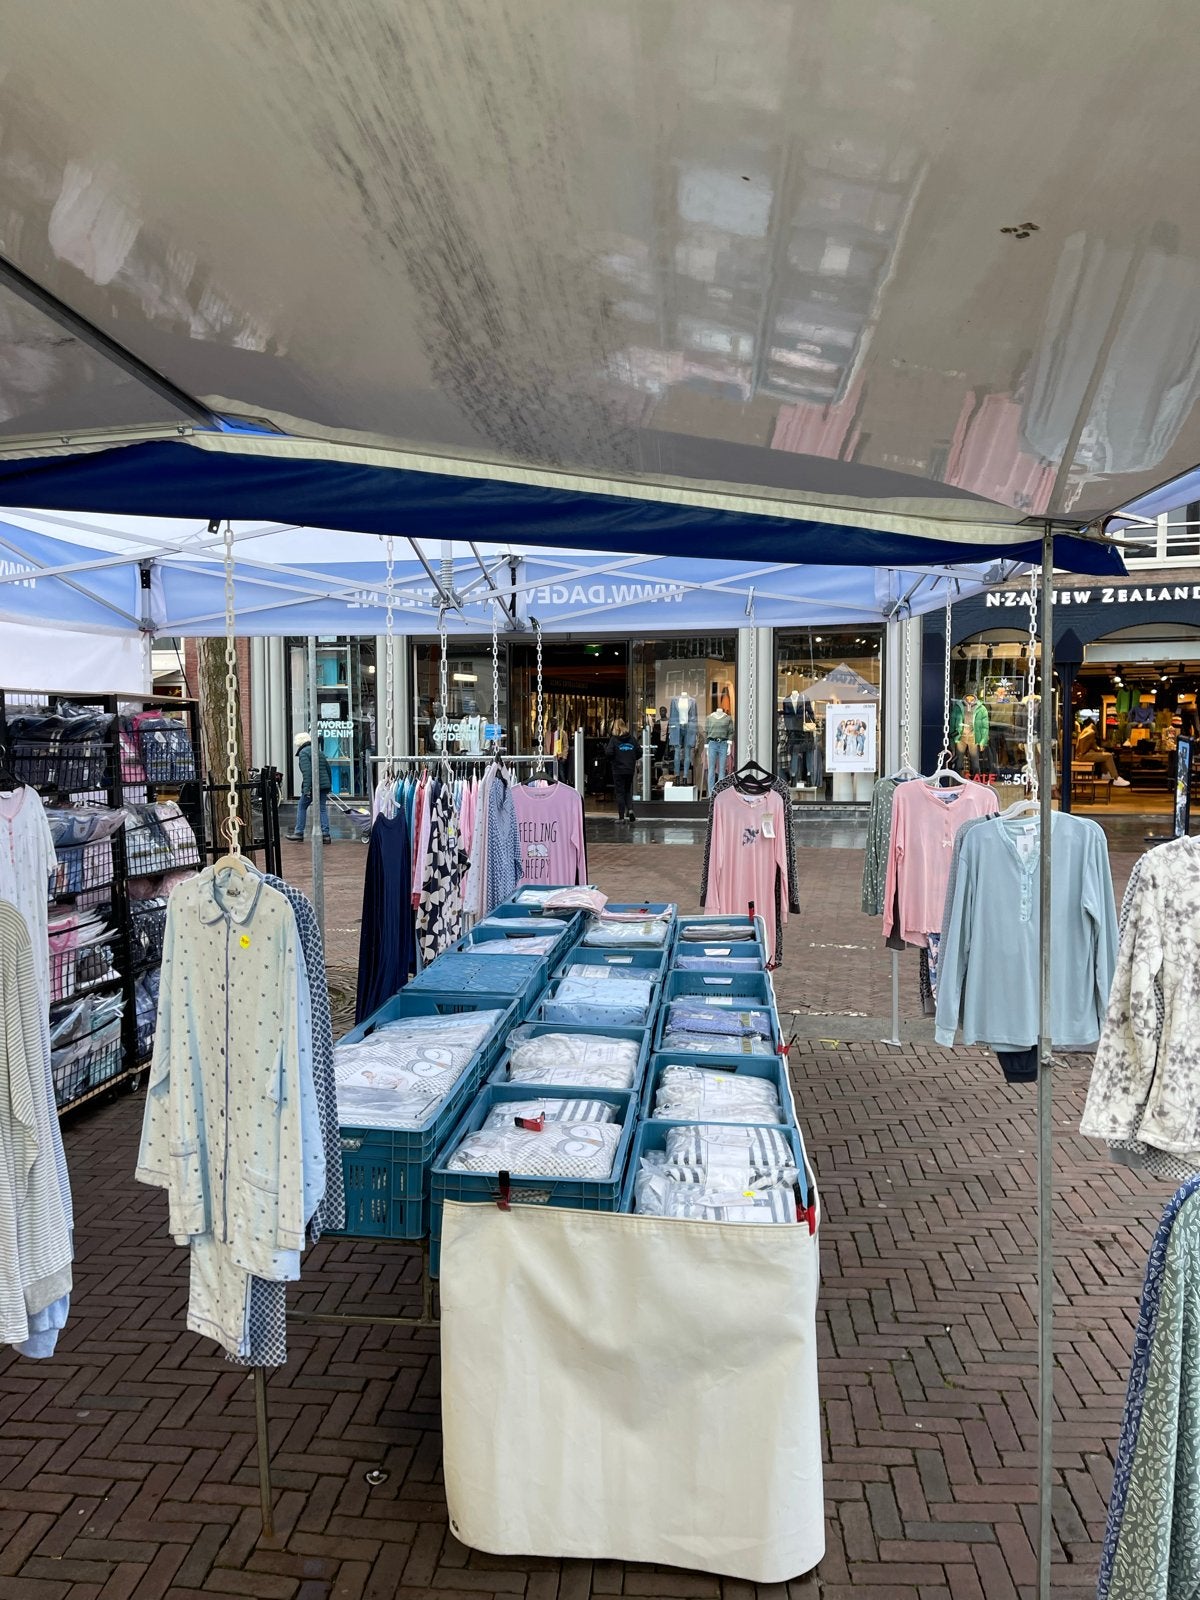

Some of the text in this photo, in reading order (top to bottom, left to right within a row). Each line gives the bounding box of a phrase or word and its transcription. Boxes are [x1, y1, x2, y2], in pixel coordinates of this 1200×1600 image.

[1101, 587, 1200, 603] ZEALAND
[323, 729, 354, 738] DENIM
[964, 773, 997, 785] SALE
[518, 820, 558, 843] FEELING
